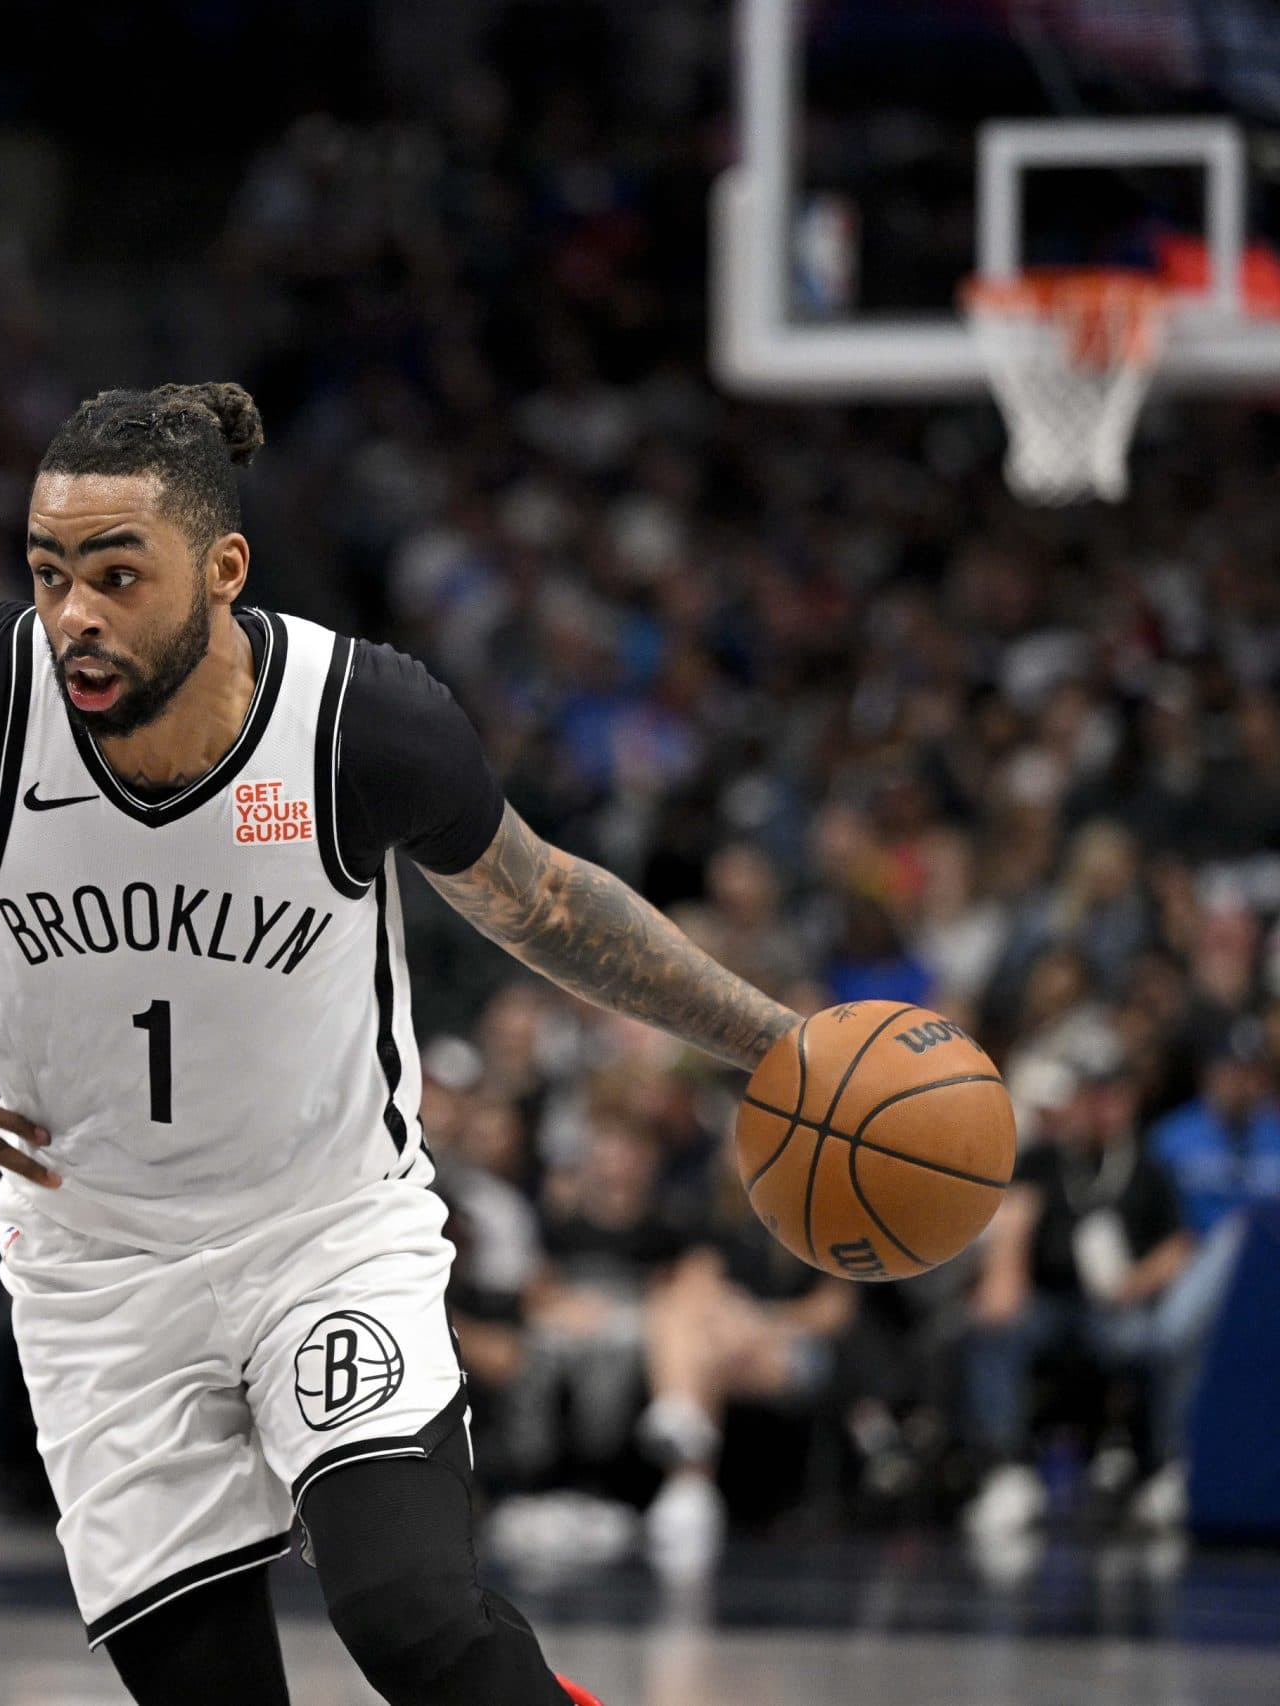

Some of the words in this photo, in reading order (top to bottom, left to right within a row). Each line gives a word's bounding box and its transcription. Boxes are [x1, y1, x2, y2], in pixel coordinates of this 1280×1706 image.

[235, 782, 283, 803] GET
[236, 800, 309, 823] YOUR
[235, 820, 313, 843] GUIDE
[131, 999, 173, 1125] 1
[324, 1328, 359, 1413] B
